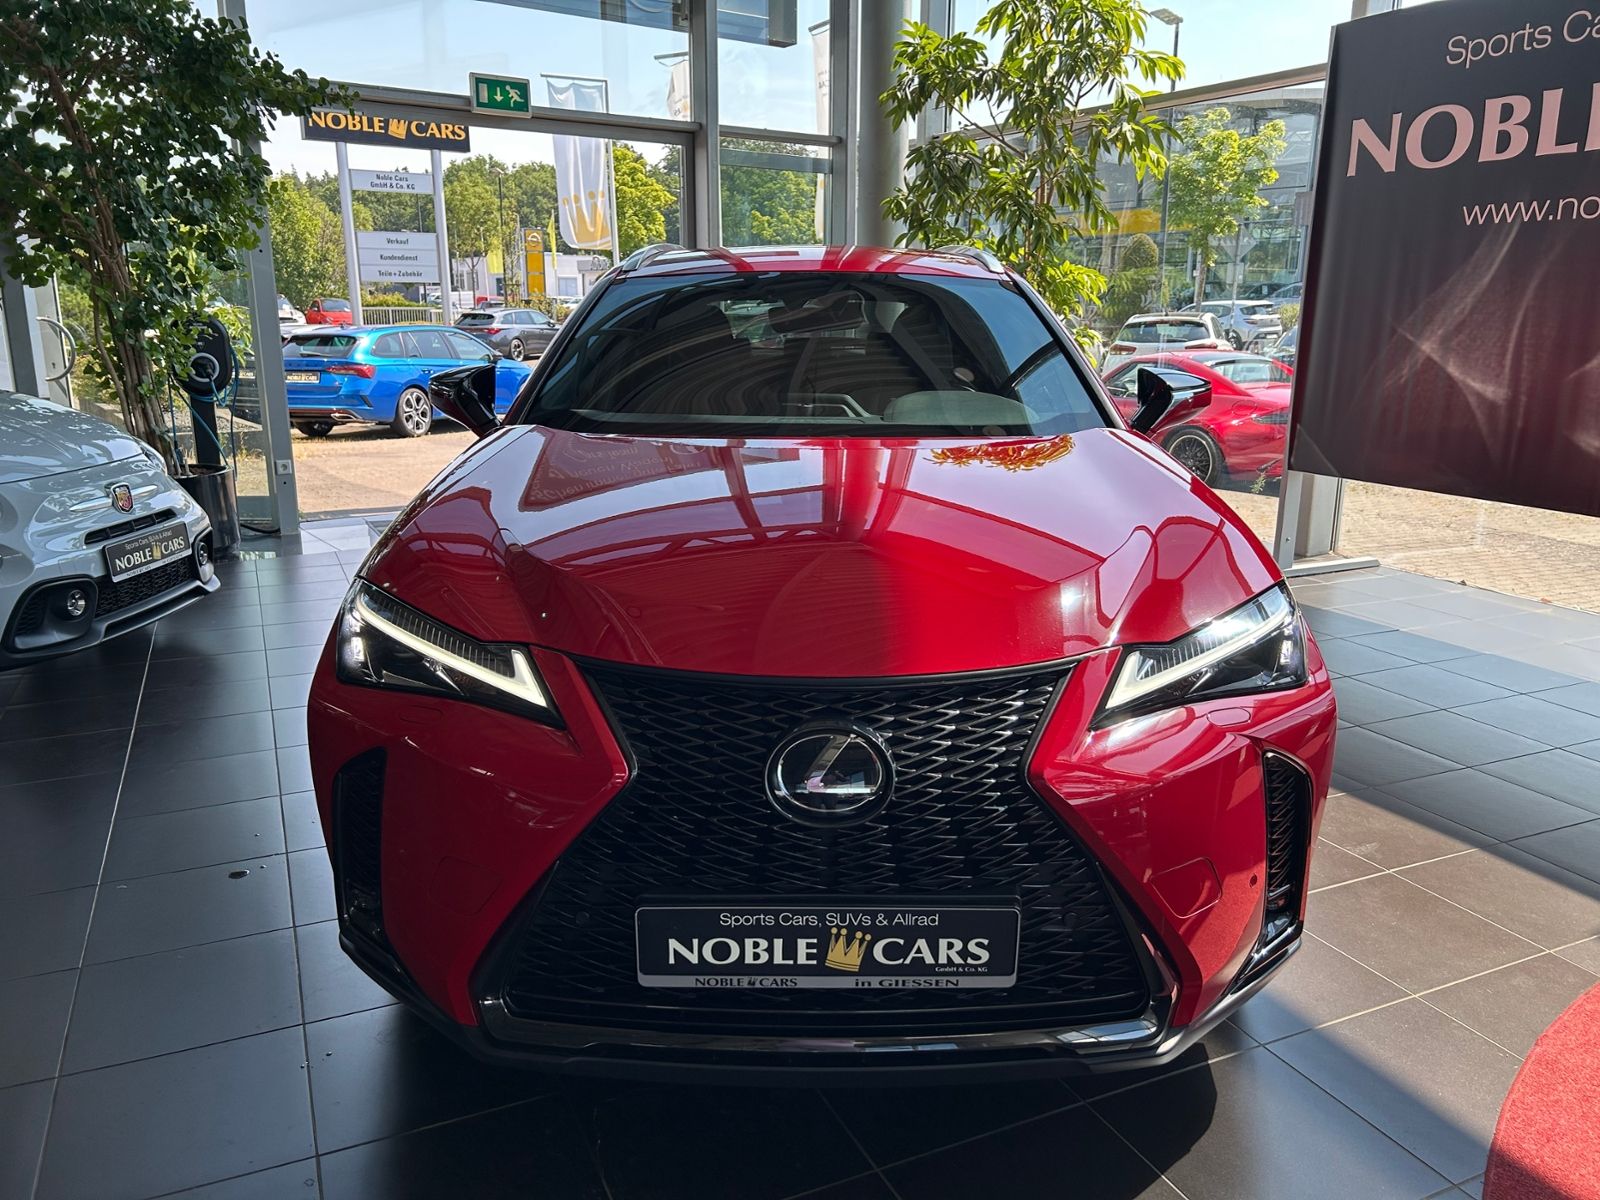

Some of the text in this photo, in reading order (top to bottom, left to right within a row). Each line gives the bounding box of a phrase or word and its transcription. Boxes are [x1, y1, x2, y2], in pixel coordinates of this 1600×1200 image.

[1446, 23, 1552, 68] Sports
[308, 111, 466, 140] NOBLE CARS
[115, 548, 152, 571] NOBLE
[161, 536, 185, 554] CARS
[719, 913, 939, 928] Sports Cars, SUVs & Allrad
[668, 937, 990, 965] NOBLE CARS
[695, 978, 798, 987] NOBLE CARS
[855, 979, 960, 987] in GIESSEN
